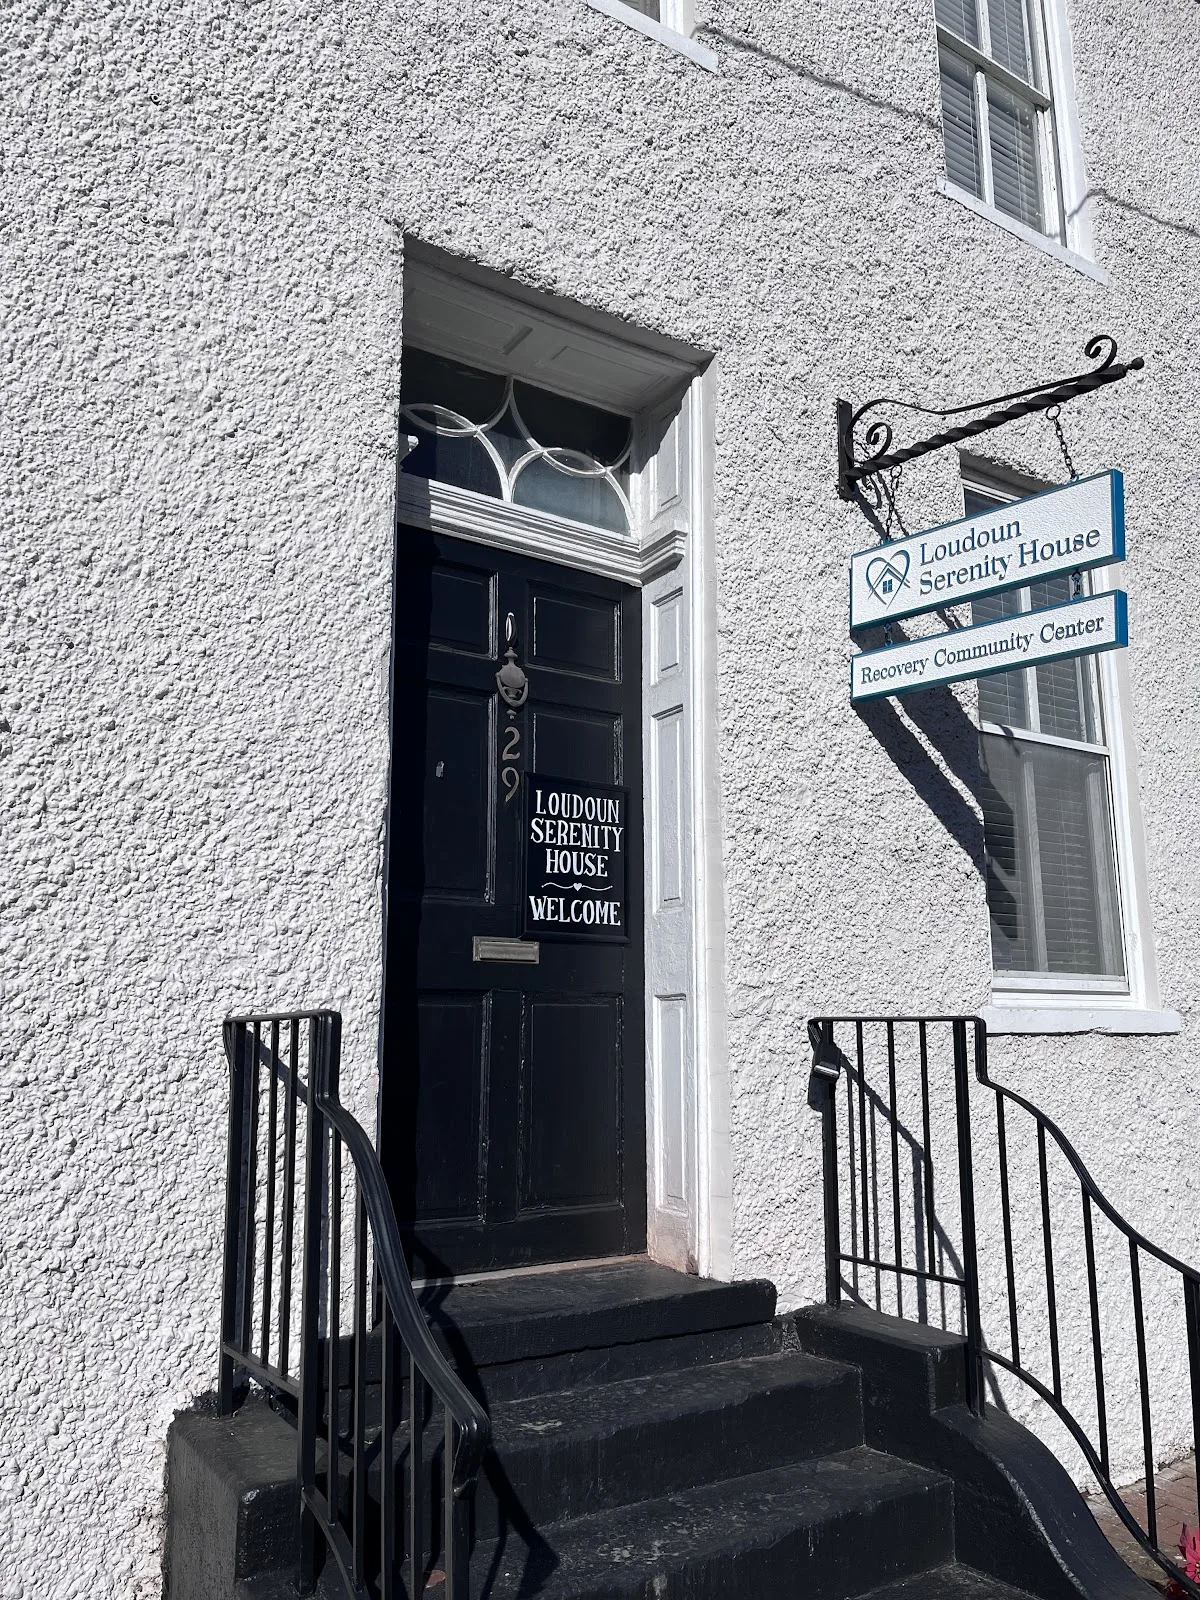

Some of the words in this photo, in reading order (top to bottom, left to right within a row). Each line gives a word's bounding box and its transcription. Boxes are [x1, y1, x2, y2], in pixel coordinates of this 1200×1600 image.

[919, 553, 1012, 596] Serenity
[1018, 529, 1101, 567] House
[920, 520, 1021, 566] Loudoun
[860, 658, 929, 685] Recovery
[933, 632, 1034, 667] Community
[1039, 616, 1105, 643] Center
[501, 726, 521, 802] 29
[535, 789, 620, 824] LOUDOUN
[530, 818, 624, 853] SERENITY
[546, 848, 608, 877] HOUSE
[529, 895, 621, 926] WELCOME
